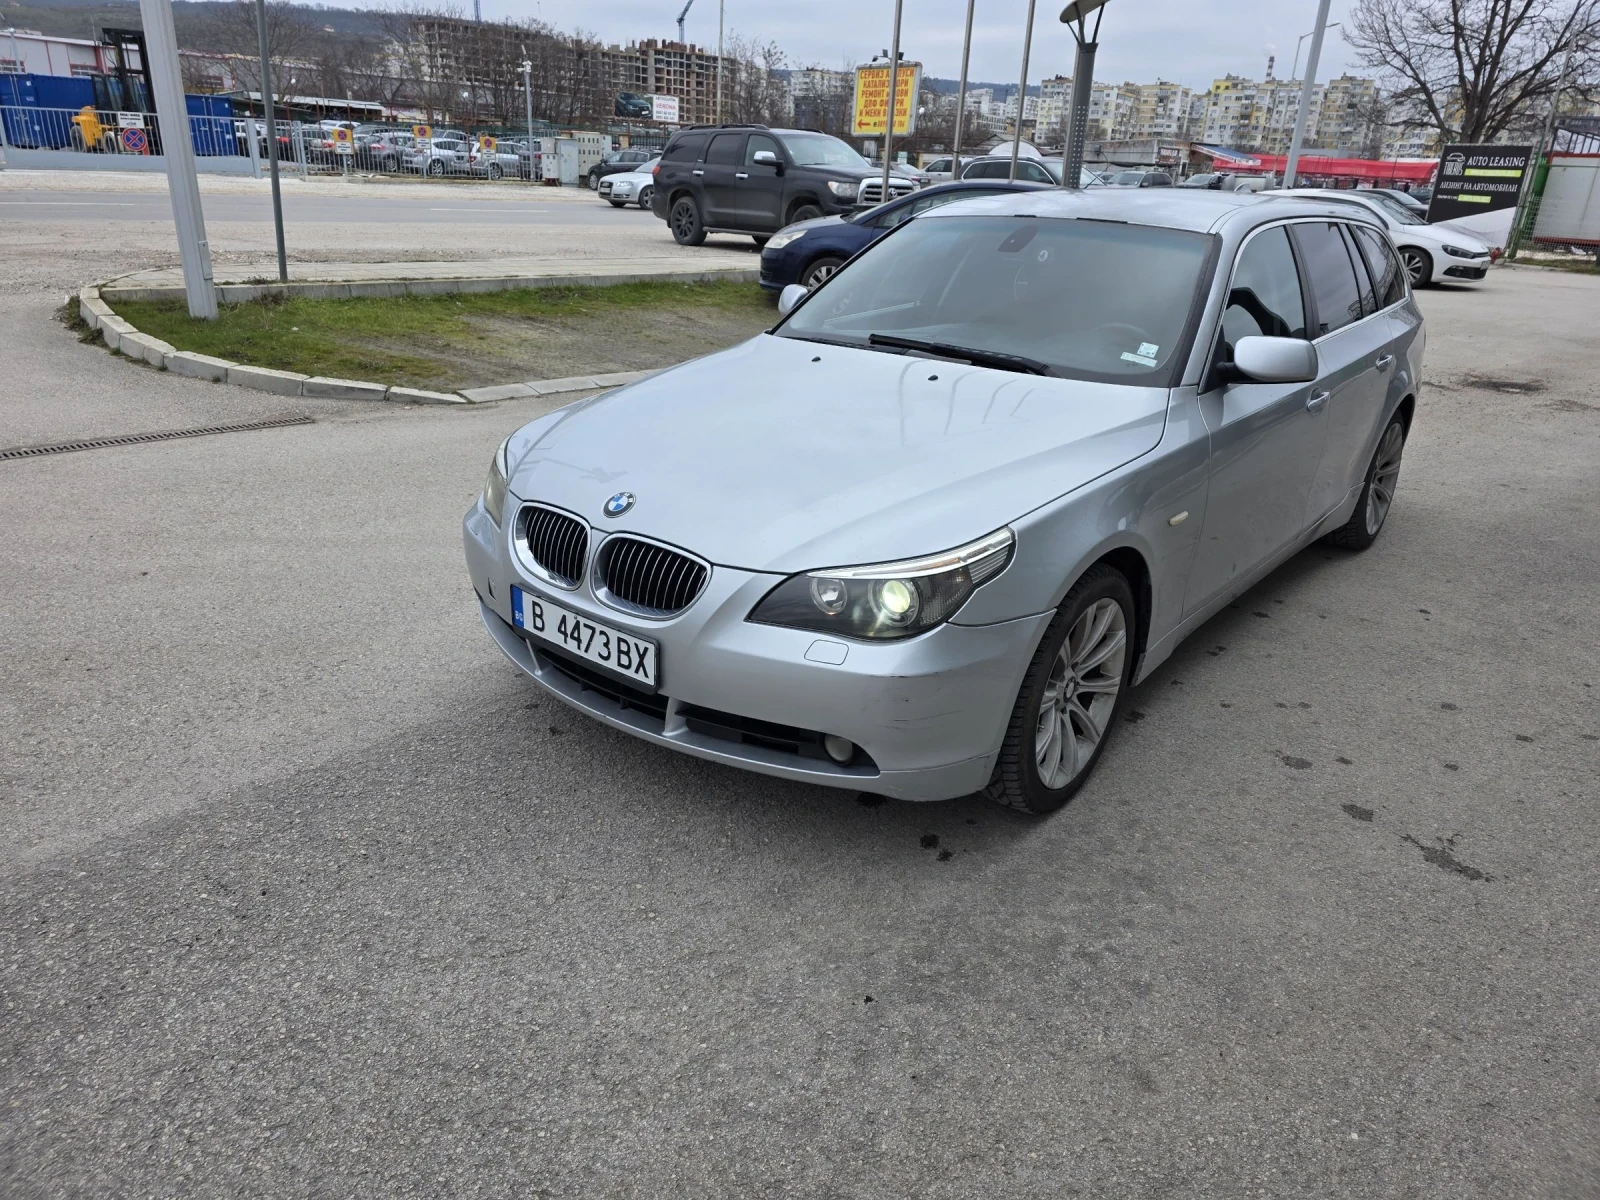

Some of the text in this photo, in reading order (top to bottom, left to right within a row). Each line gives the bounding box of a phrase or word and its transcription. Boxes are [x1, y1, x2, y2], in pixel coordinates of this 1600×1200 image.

[860, 68, 915, 79] СЕРВИЗ АПУСИ
[863, 78, 909, 88] КАТАЛИЗОРИ
[861, 89, 885, 98] РЕМОНТ
[864, 108, 882, 117] МЕКИ
[882, 108, 908, 117] ВЗКИ
[1467, 156, 1525, 167] AUTO LEASING
[1440, 181, 1518, 193] ЛИЗИНГ НА АВТОМОБИЛИ
[515, 610, 523, 622] BG
[532, 600, 649, 679] B 4473 BX
